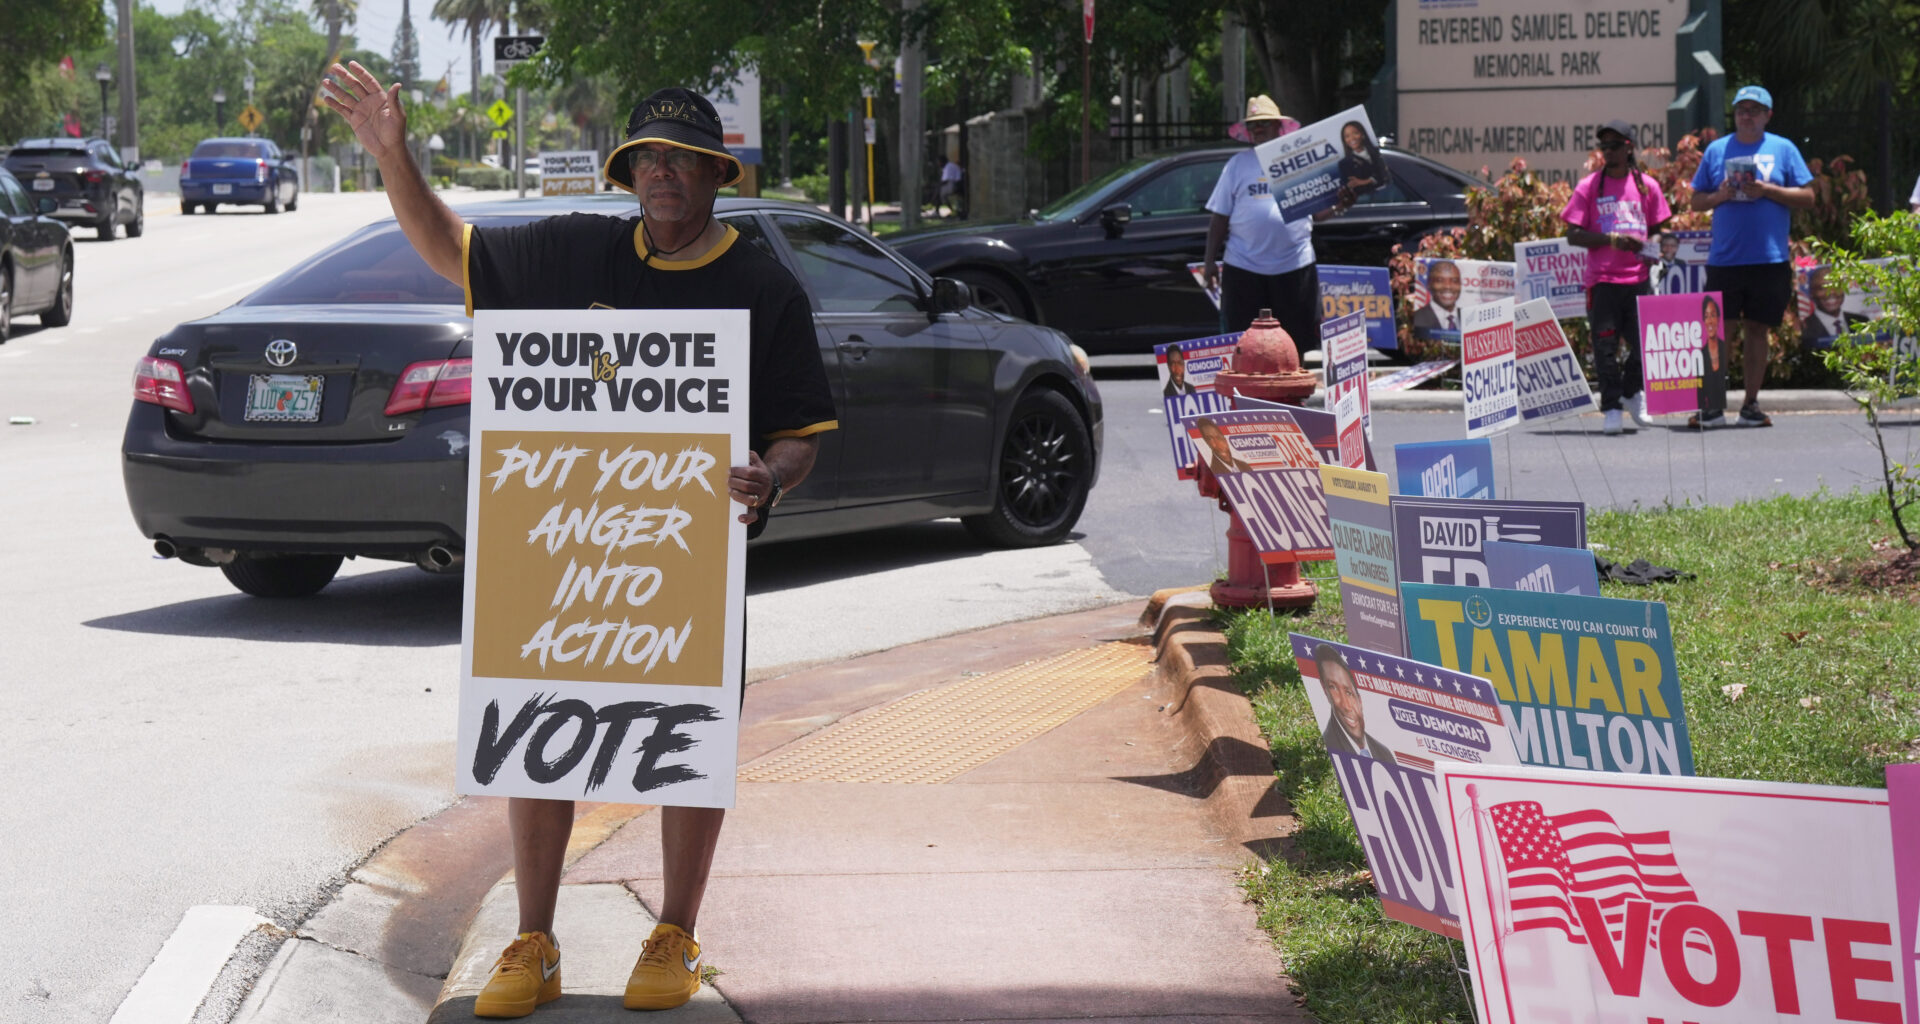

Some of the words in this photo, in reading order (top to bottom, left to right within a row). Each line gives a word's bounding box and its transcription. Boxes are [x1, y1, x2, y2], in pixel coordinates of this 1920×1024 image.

[1419, 15, 1503, 44] REVEREND
[1511, 13, 1578, 41] SAMUEL
[1585, 10, 1661, 38] DELEVOE
[1474, 53, 1554, 78] MEMORIAL
[1561, 51, 1601, 75] PARK
[1408, 125, 1565, 153] AFRICAN-AMERICAN
[543, 166, 566, 174] YOUR
[569, 165, 595, 174] VOICE
[544, 156, 567, 164] YOUR
[570, 155, 591, 164] VOTE
[1268, 143, 1338, 178] SHEILA
[1280, 178, 1341, 209] DEMOCRAT
[1285, 173, 1331, 198] STRONG
[1526, 251, 1586, 273] VERONI
[1528, 246, 1556, 255] VOTE
[1463, 278, 1515, 289] JOSEPH
[1490, 267, 1514, 277] Rod
[1322, 295, 1391, 319] OSTER
[495, 331, 604, 367] YOUR
[612, 331, 716, 367] VOTE
[1465, 325, 1514, 361] WASSERMAN
[593, 351, 619, 382] is
[1188, 360, 1221, 372] DEMOCRAT
[1465, 359, 1515, 403] SCHULTZ
[1516, 353, 1580, 397] CHULTZ
[488, 376, 597, 412] YOUR
[607, 377, 730, 413] VOICE
[1231, 436, 1275, 449] DEMOCRAT
[1272, 434, 1319, 468] DALE
[486, 441, 594, 495] PUT
[591, 441, 716, 498] YOUR
[527, 499, 692, 557] ANGER
[1333, 523, 1365, 555] OLIVER
[1423, 520, 1477, 547] DAVID
[550, 556, 664, 614] INTO
[1358, 560, 1389, 583] CONGRESS
[1351, 591, 1377, 611] DEMOCRAT
[1498, 613, 1558, 630] EXPERIENCE
[1559, 618, 1581, 632] YOU
[1583, 620, 1604, 635] CAN
[1605, 623, 1640, 638] COUNT
[1641, 626, 1658, 640] ON
[520, 616, 692, 676] ACTION
[1418, 598, 1671, 719] TAMAR
[1354, 673, 1375, 690] LET'S
[1371, 677, 1394, 694] MAKE
[1391, 682, 1436, 705] PROSPERITY
[1432, 691, 1455, 709] MORE
[1452, 697, 1499, 722] AFFORDABLE
[1392, 706, 1420, 726] VOTE
[1421, 714, 1486, 744] DEMOCRAT
[1500, 704, 1682, 777] MILTON
[471, 691, 725, 797] VOTE
[1424, 738, 1440, 752] U.S.
[1440, 742, 1482, 764] CONGRESS
[1569, 895, 1904, 1024] VOTE
